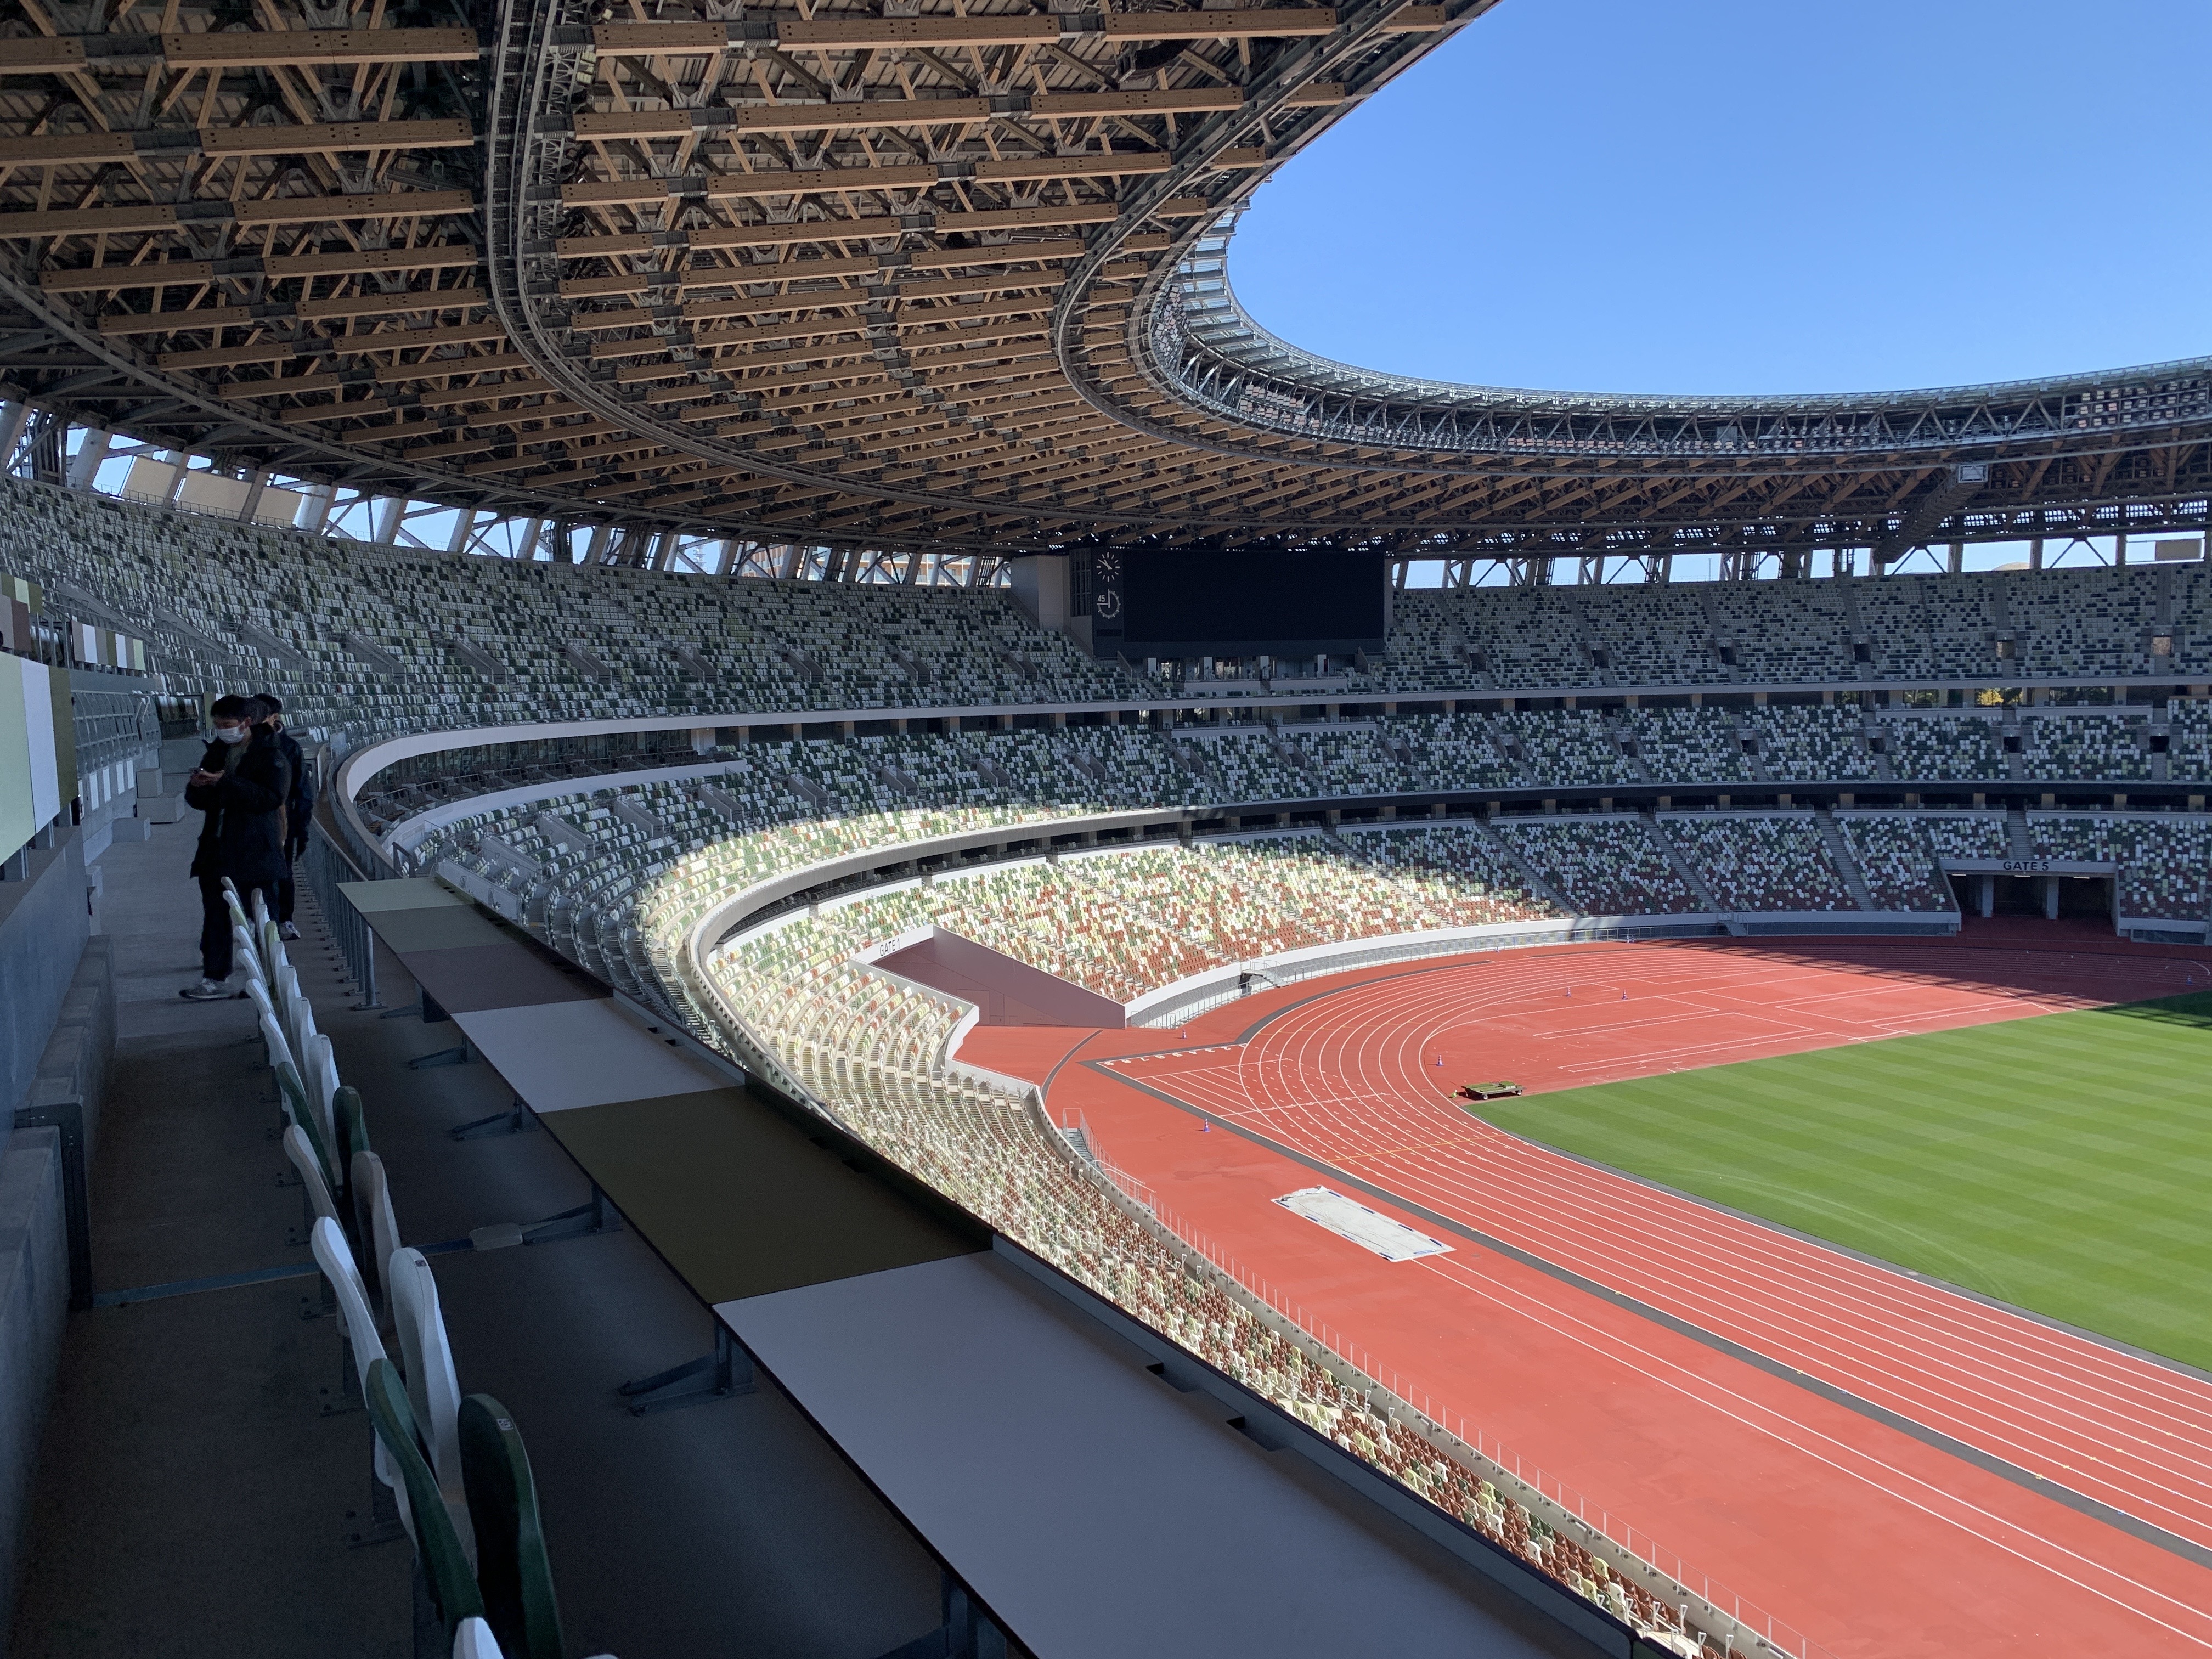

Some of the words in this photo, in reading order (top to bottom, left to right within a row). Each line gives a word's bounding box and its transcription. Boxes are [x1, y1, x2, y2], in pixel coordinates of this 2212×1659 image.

[2003, 861, 2038, 871] GATE
[2042, 862, 2049, 871] 5
[880, 940, 895, 956] GATE
[897, 938, 900, 949] 1
